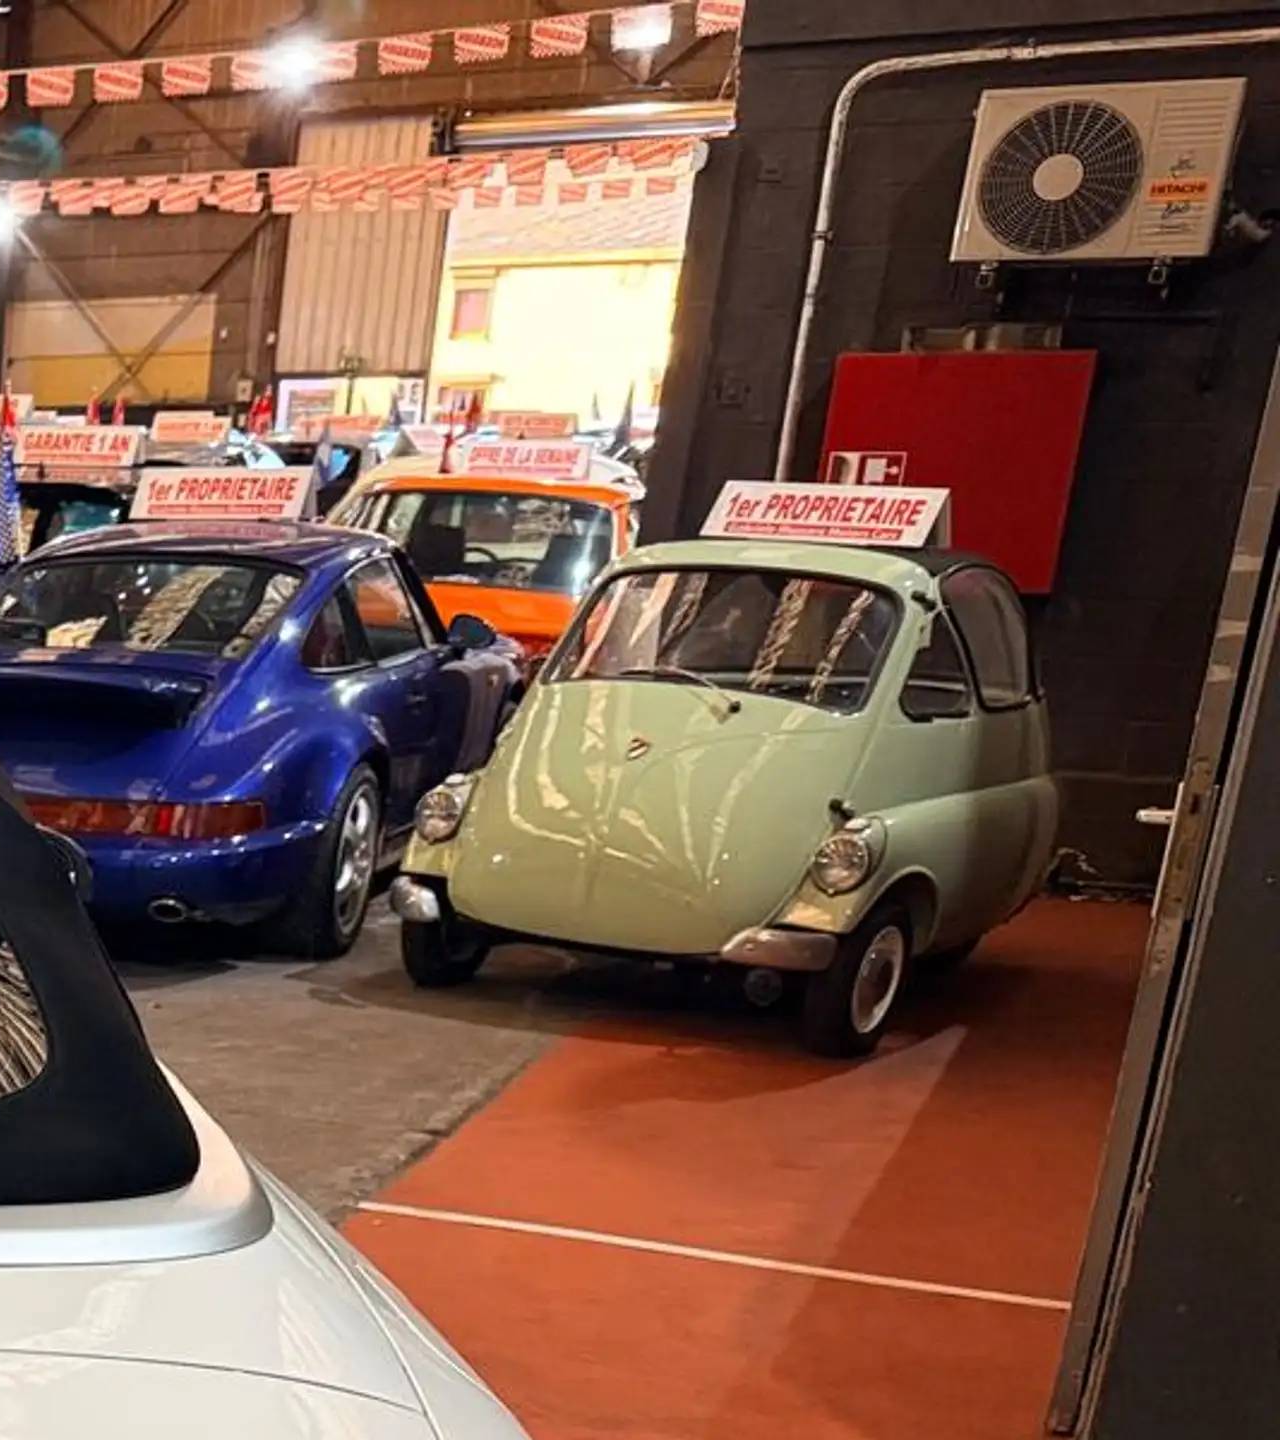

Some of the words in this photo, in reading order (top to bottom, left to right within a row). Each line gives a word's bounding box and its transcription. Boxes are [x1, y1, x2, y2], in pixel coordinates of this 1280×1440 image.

[1150, 181, 1208, 195] HITACHI
[24, 432, 96, 450] GARANTIE
[108, 434, 132, 451] AN
[147, 478, 172, 501] 1er
[175, 477, 299, 501] PROPRIETAIRE
[724, 491, 762, 519] 1er
[761, 493, 928, 526] PROPRIETAIRE
